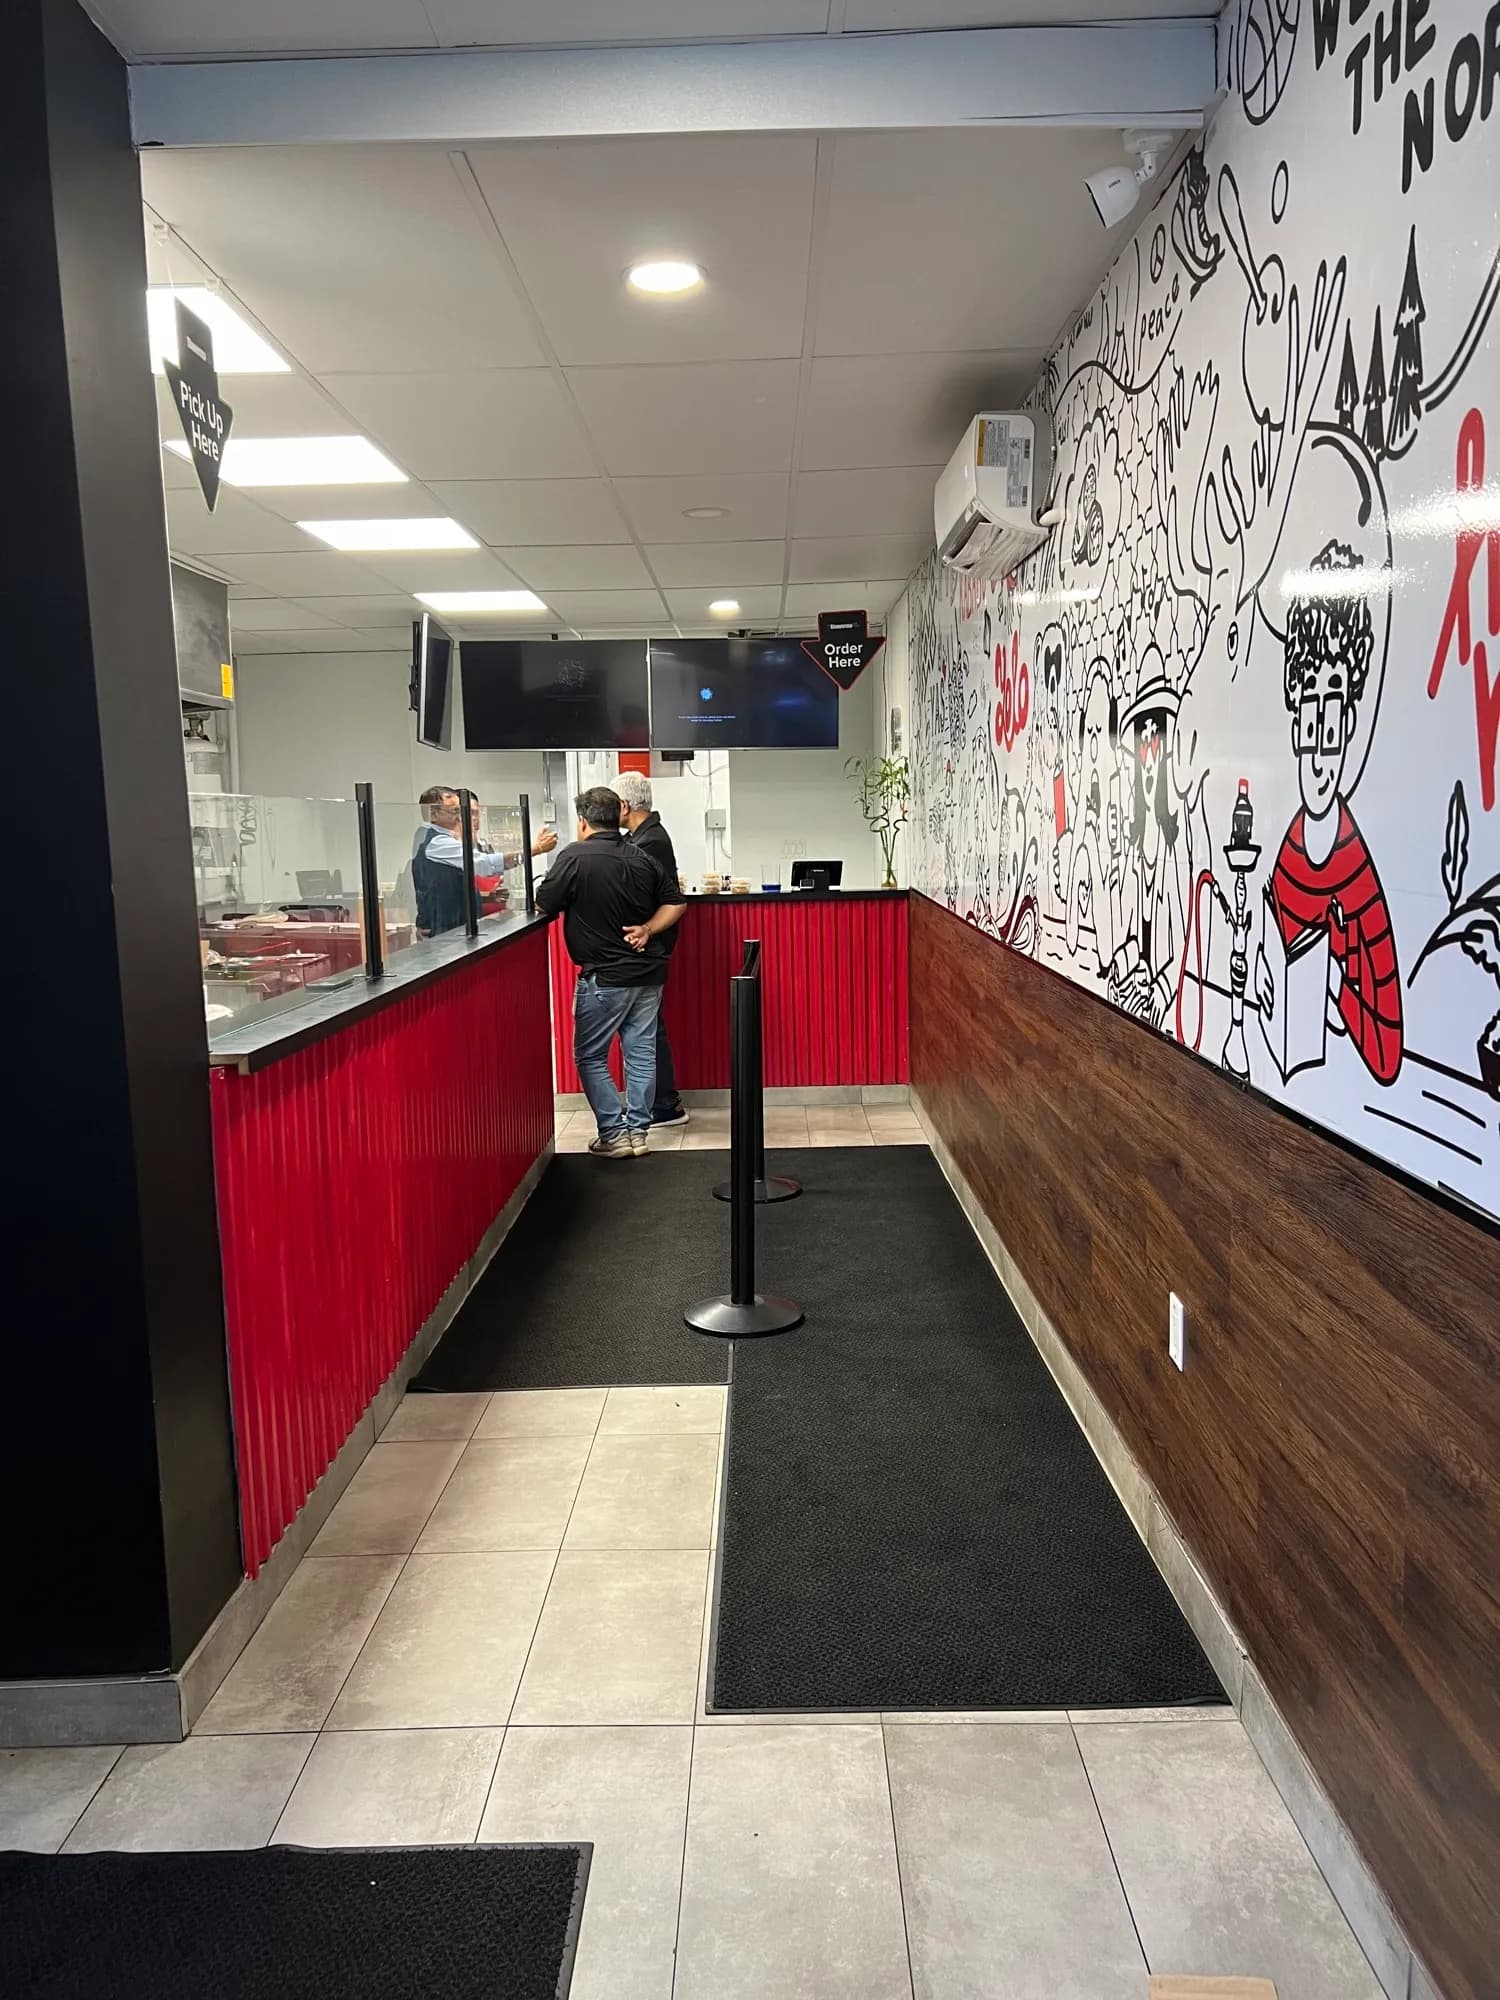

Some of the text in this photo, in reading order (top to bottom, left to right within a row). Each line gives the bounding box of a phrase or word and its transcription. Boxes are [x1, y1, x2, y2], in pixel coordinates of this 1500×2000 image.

[1312, 0, 1371, 71] W
[1345, 0, 1436, 135] THE
[179, 380, 224, 439] Pick Up
[191, 420, 220, 462] Here
[824, 643, 863, 656] Order
[828, 656, 861, 668] Here
